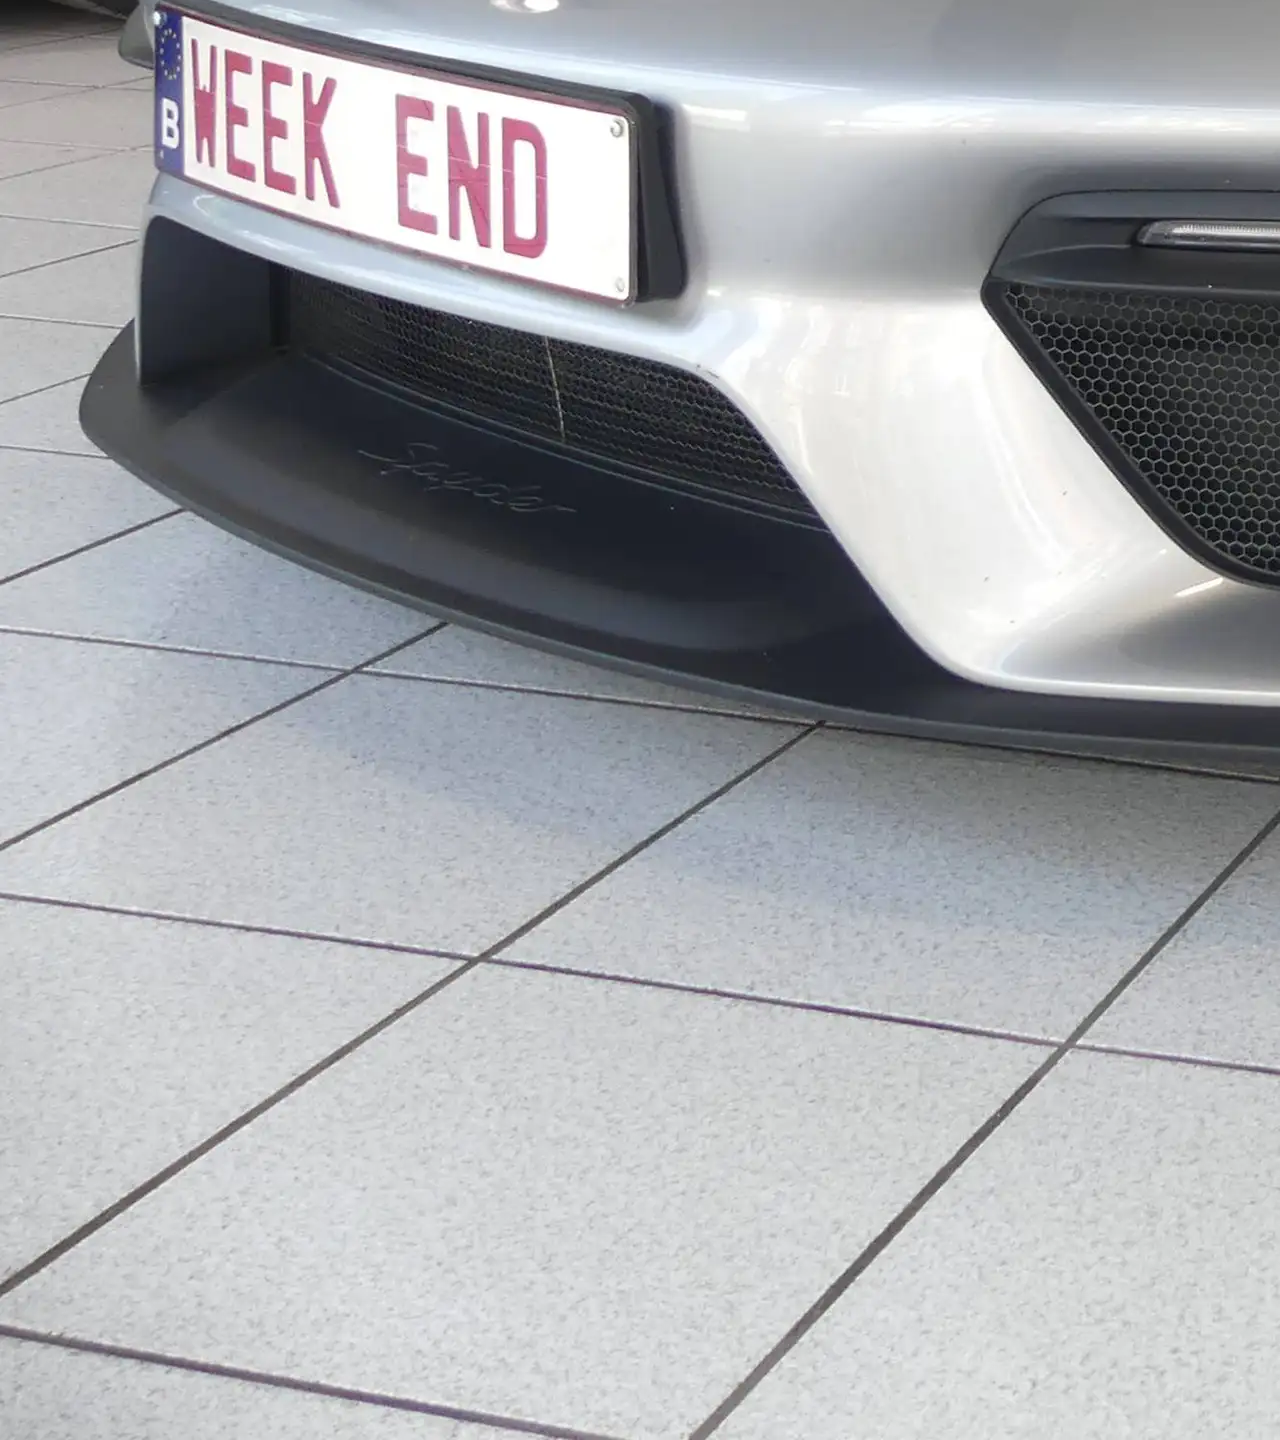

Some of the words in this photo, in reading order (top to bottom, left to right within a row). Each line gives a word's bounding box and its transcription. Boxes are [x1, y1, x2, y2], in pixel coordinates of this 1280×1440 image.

[162, 97, 180, 149] B
[191, 38, 340, 209] WEEK
[395, 93, 548, 259] END
